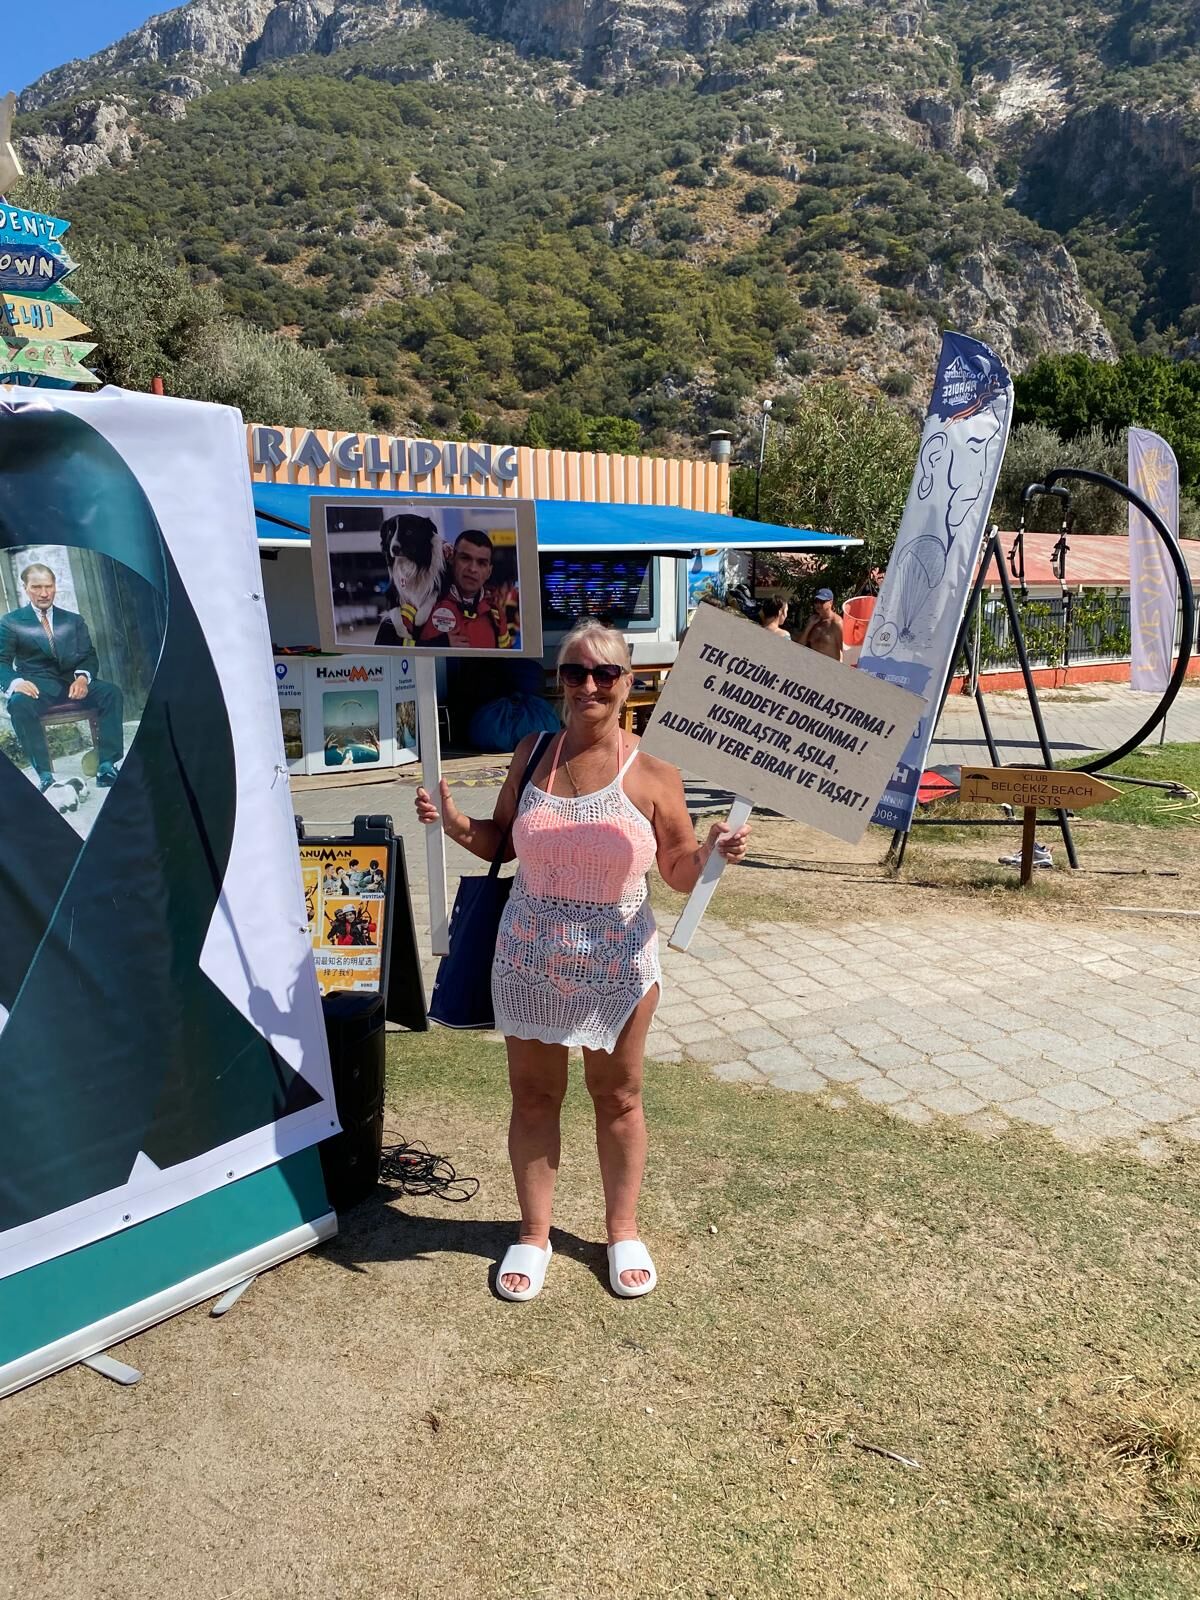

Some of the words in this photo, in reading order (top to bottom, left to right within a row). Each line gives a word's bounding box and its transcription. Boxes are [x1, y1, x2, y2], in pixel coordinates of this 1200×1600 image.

[252, 426, 519, 481] RAGLIDING
[699, 643, 730, 668] TEK
[725, 657, 780, 690] ÇÖZÜM:
[703, 675, 717, 692] 6.
[718, 681, 789, 721] MADDEYE
[658, 711, 718, 746] ALDIĞIN
[717, 734, 754, 761] YERE
[796, 769, 818, 789] VE
[707, 703, 792, 754] KISIRLAŞTIR,
[1012, 793, 1062, 806] GUESTS
[1023, 773, 1048, 782] CLUB
[1051, 785, 1093, 797] BEACH
